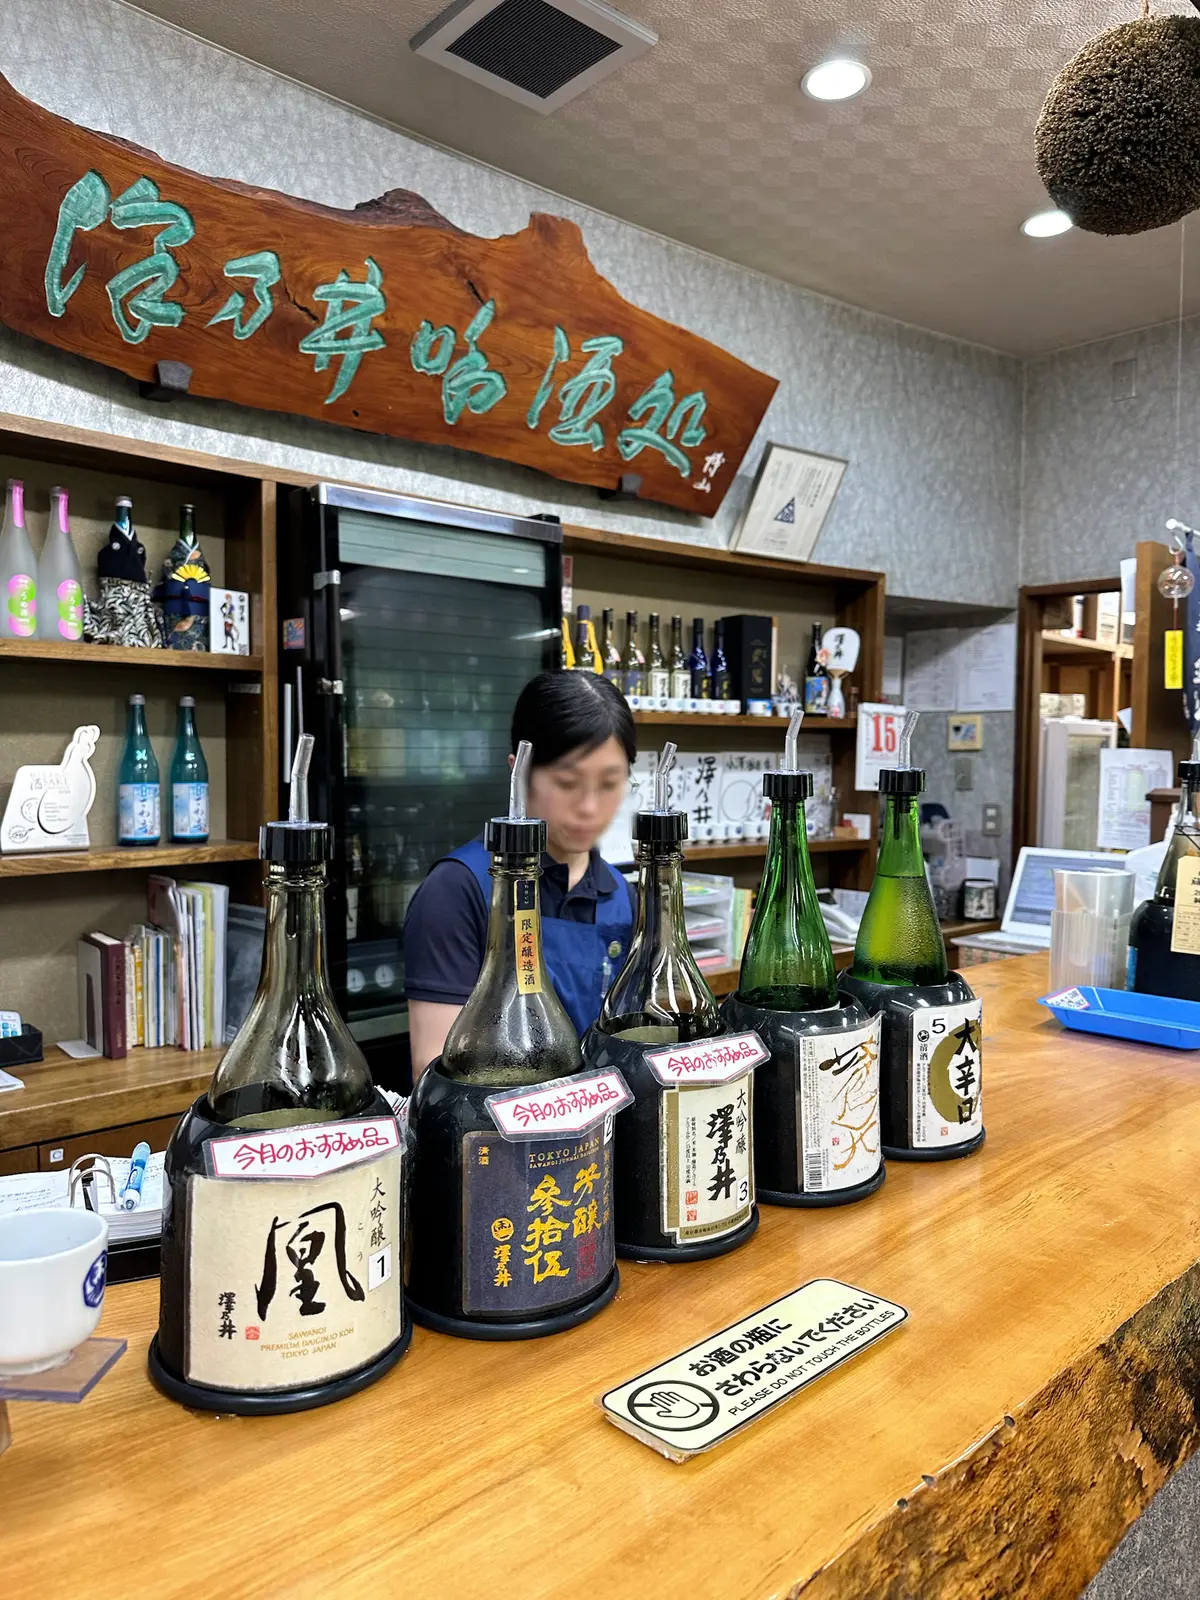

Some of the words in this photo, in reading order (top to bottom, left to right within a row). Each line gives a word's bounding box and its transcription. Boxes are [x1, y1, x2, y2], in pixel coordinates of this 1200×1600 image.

[872, 712, 897, 752] 15
[521, 919, 535, 986] 限定醸造酒
[932, 1017, 946, 1034] 5
[667, 1042, 759, 1077] 今月のおすすめ品
[953, 1017, 976, 1125] 大辛口
[512, 1082, 620, 1127] 今月のおすすめ品
[605, 1114, 612, 1138] 2
[735, 1088, 747, 1155] 大吟醸
[233, 1127, 389, 1170] 今月のおすすめ品
[528, 1149, 570, 1162] TOKYO
[573, 1137, 600, 1156] JAPAN
[529, 1160, 558, 1169] SAWANOI
[706, 1103, 737, 1200] 澤乃井
[370, 1176, 387, 1248] 大吟醸
[739, 1181, 748, 1202] 3
[376, 1255, 385, 1278] 1
[493, 1244, 513, 1288] 澤乃井
[218, 1291, 238, 1340] 澤乃井
[288, 1327, 327, 1340] SAWANOI
[260, 1341, 300, 1352] PREMIUM
[302, 1333, 338, 1347] DAIGINJO
[339, 1327, 354, 1339] KOH
[282, 1349, 309, 1359] TOKYO
[312, 1342, 337, 1354] JAPAN
[688, 1318, 793, 1377] お酒の瓶に
[714, 1297, 880, 1397] さわらないでください
[728, 1387, 774, 1416] PLEASE
[773, 1378, 788, 1392] DO
[788, 1364, 806, 1380] NOT
[805, 1345, 839, 1371] TOUCH
[838, 1332, 858, 1350] THE
[857, 1309, 896, 1338] BOTTLES
